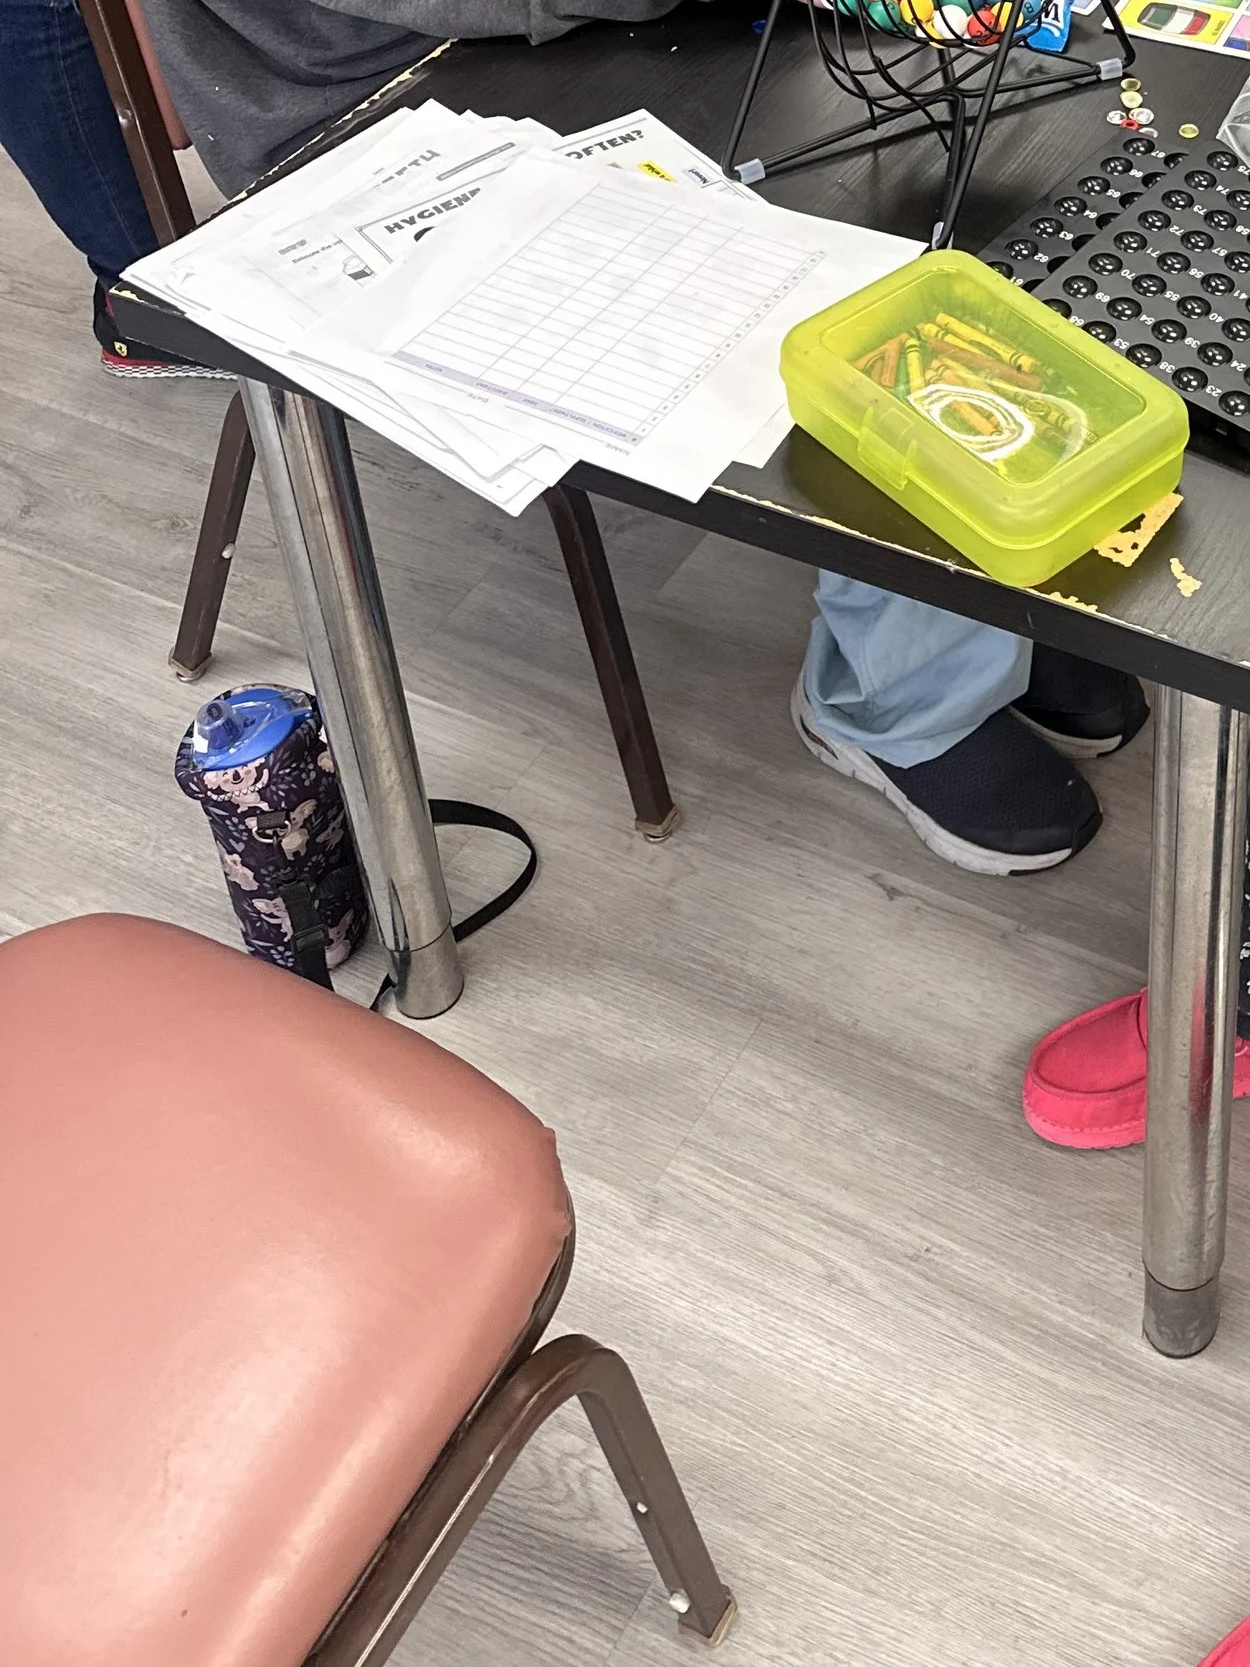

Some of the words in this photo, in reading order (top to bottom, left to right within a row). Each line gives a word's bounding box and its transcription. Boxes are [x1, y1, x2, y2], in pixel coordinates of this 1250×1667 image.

[1034, 253, 1049, 263] 62
[1059, 231, 1074, 240] 63
[1083, 209, 1098, 218] 64
[1106, 188, 1121, 198] 65
[1129, 169, 1143, 178] 66
[1151, 150, 1166, 158] 67
[1095, 292, 1111, 303] 69
[1120, 269, 1136, 280] 70
[1146, 247, 1161, 257] 71
[1169, 225, 1184, 236] 72
[1193, 204, 1208, 215] 73
[1215, 184, 1230, 195] 74
[1113, 337, 1130, 350] 53
[1139, 314, 1155, 325] 54
[1164, 291, 1181, 301] 55
[1188, 268, 1205, 279] 56
[1212, 247, 1228, 257] 57
[1235, 225, 1250, 235] 58
[1158, 361, 1176, 373] 38
[1184, 337, 1200, 348] 39
[1208, 313, 1224, 323] 40
[1233, 290, 1249, 300] 41
[1205, 385, 1223, 397] 23
[1230, 360, 1247, 372] 24
